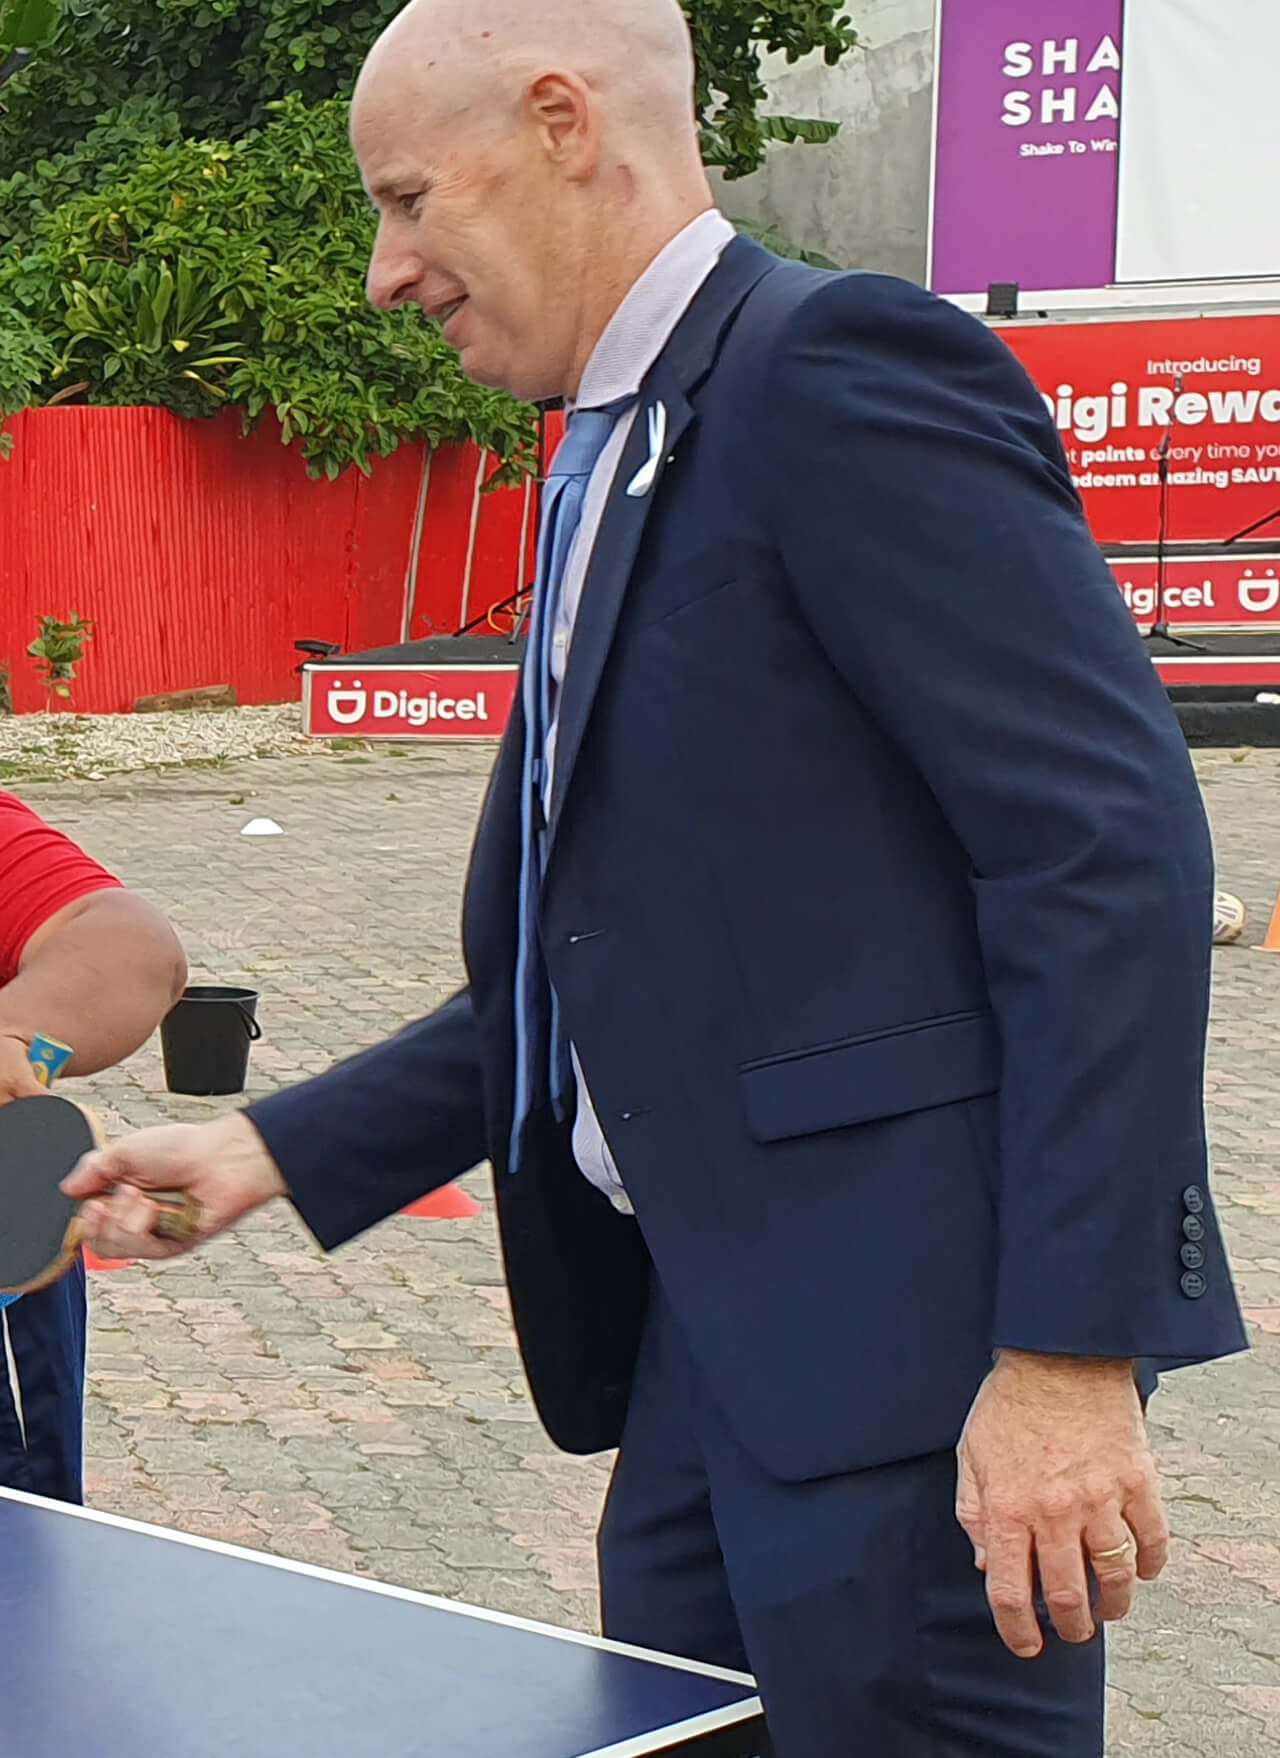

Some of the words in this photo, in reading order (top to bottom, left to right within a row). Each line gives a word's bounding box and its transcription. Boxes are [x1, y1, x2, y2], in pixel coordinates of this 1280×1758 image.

[1002, 34, 1120, 78] SHA
[1001, 83, 1119, 126] SHA
[1020, 142, 1064, 157] Shake
[1067, 140, 1086, 153] To
[1147, 355, 1261, 375] Introducing
[1081, 444, 1146, 468] points
[1207, 442, 1251, 459] time
[1255, 443, 1280, 462] yo
[1118, 580, 1215, 615] igcel
[373, 690, 488, 727] Digicel
